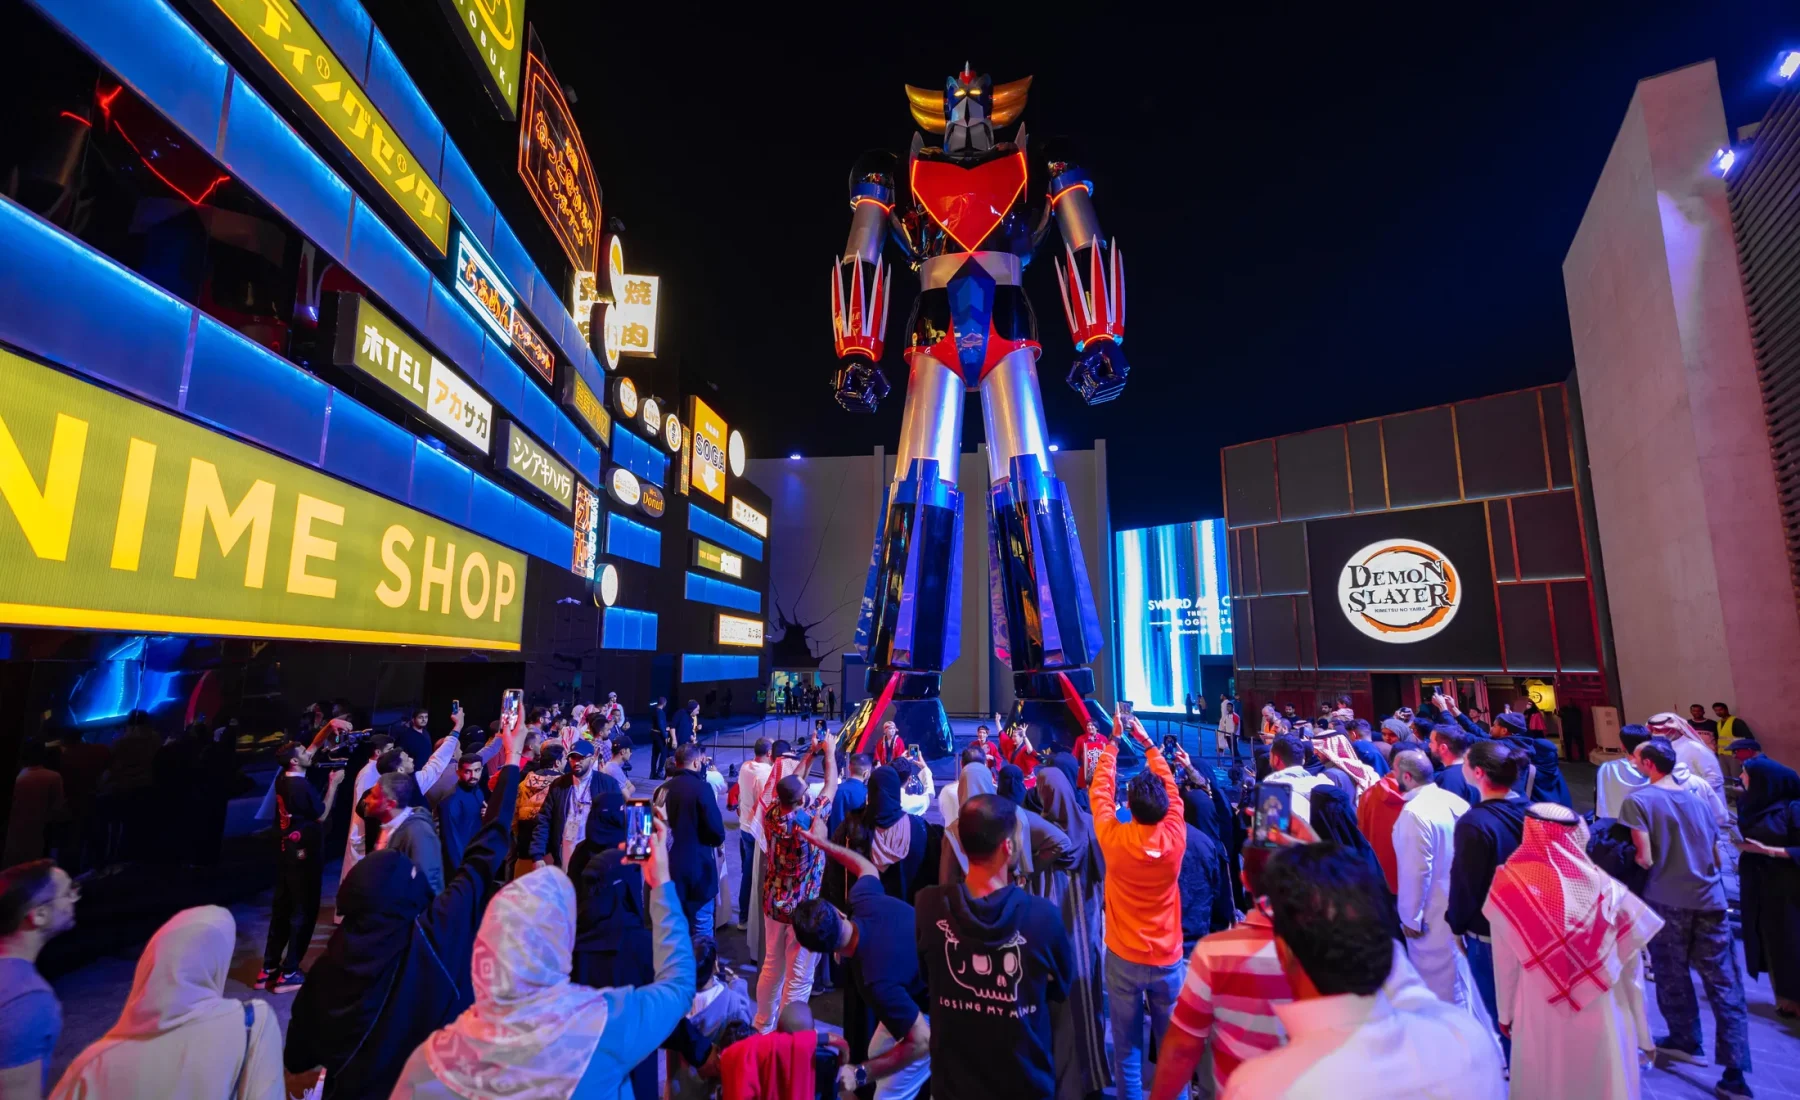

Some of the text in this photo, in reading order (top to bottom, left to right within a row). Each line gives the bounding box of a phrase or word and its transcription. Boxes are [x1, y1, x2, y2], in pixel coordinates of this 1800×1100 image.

[459, 0, 513, 96] OBUKI
[434, 377, 488, 440] アカサカ
[374, 524, 517, 624] SHOP
[1347, 559, 1451, 590] DEMON
[1148, 598, 1192, 611] SWRD
[1347, 583, 1456, 614] SLAYER
[986, 1005, 1004, 1016] MY
